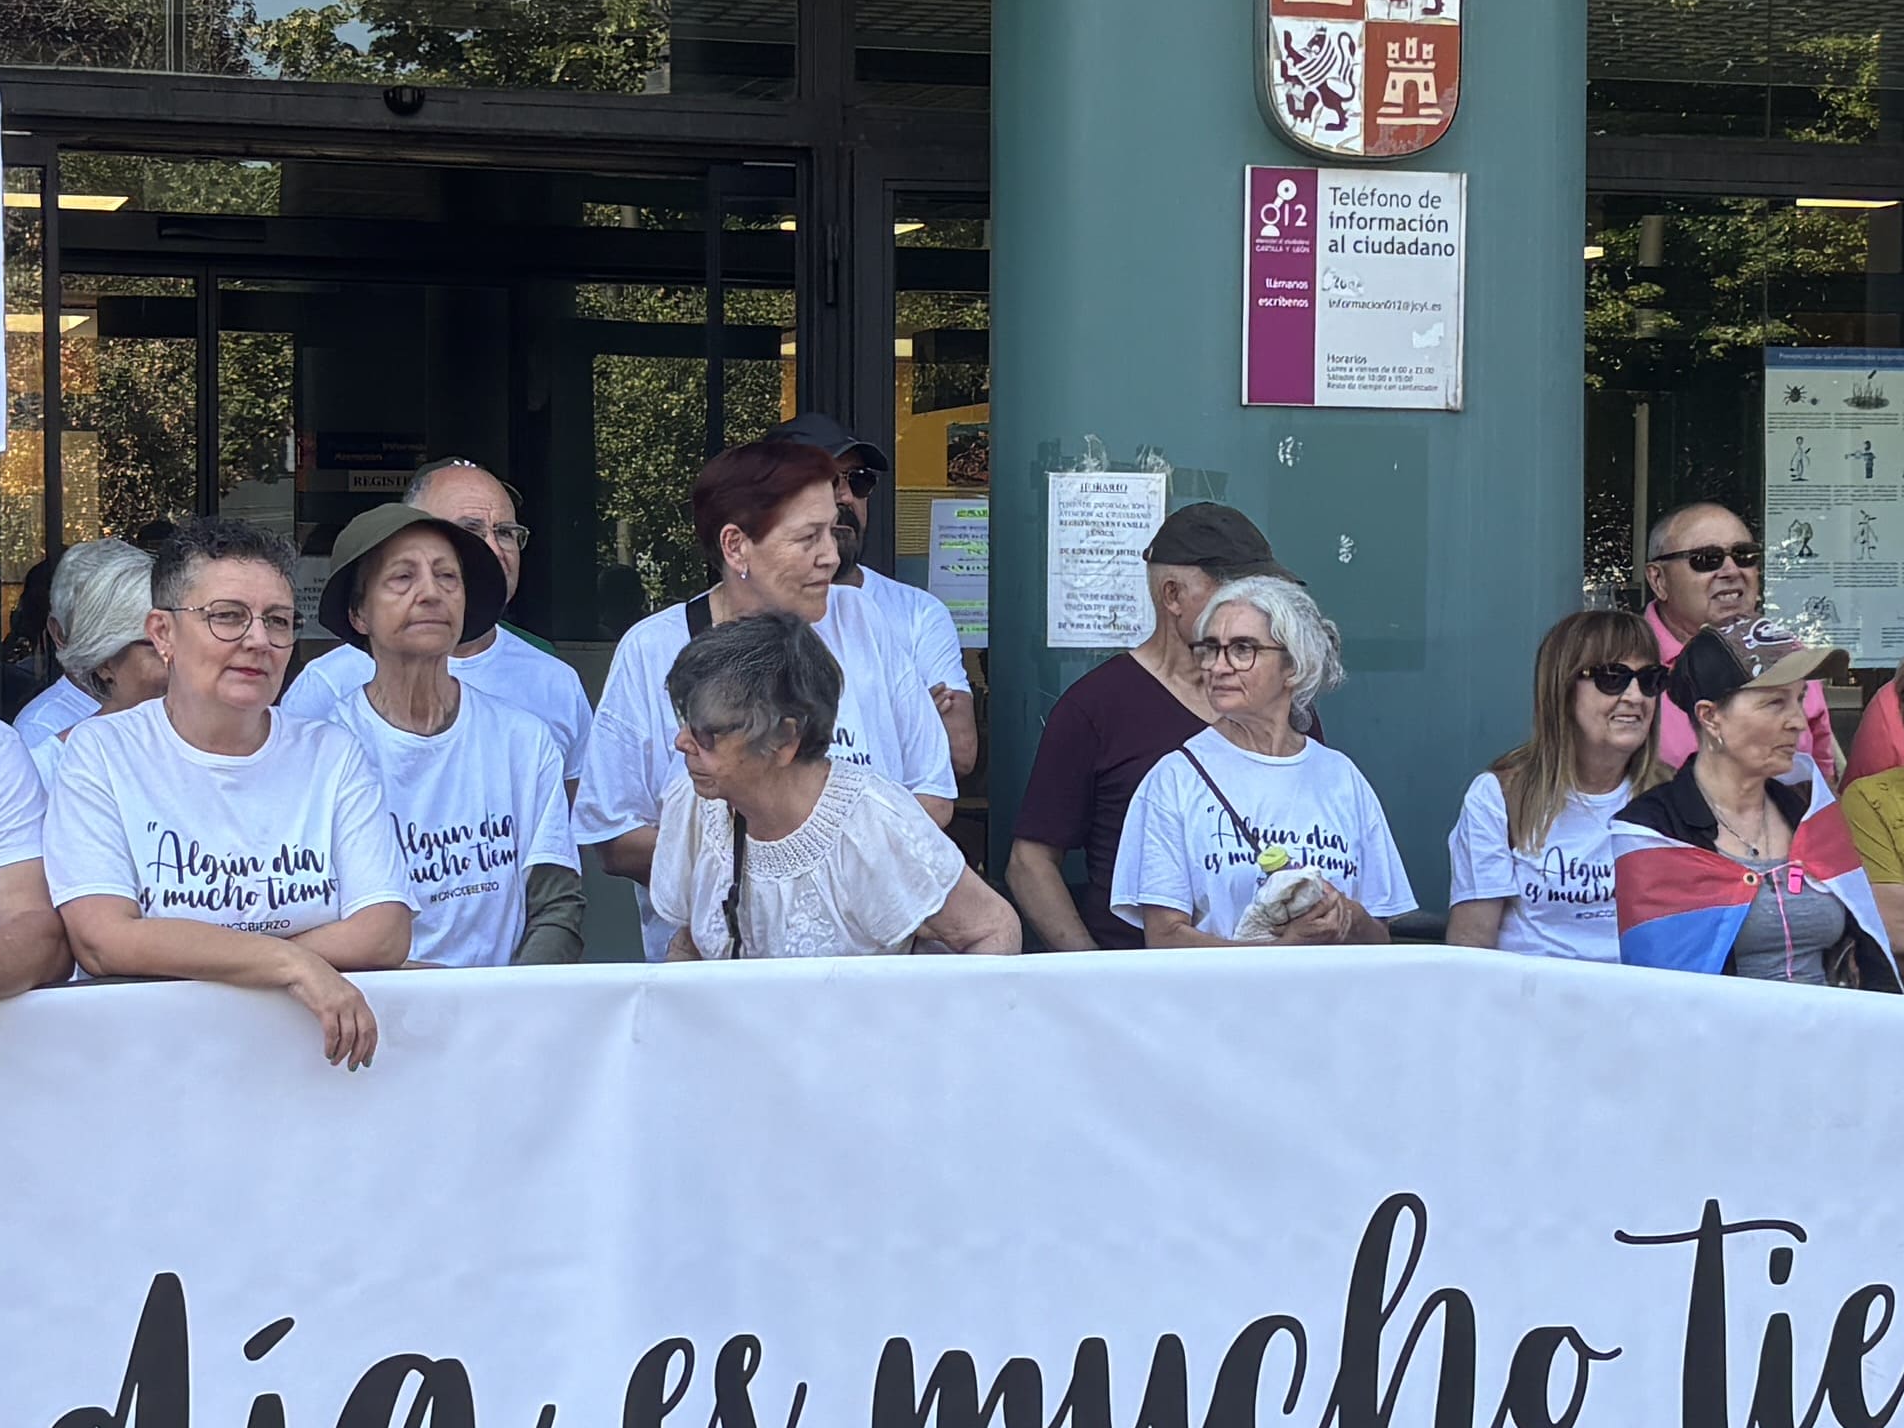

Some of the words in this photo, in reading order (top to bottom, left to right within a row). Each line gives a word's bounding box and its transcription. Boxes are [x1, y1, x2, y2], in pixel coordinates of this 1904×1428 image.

[1328, 184, 1412, 209] Teléfono
[1418, 189, 1442, 210] de
[1328, 210, 1449, 234] información
[1328, 235, 1347, 255] al
[1352, 237, 1456, 257] ciudadano
[146, 820, 265, 886] "Algún
[272, 842, 325, 874] día
[162, 880, 262, 912] mucho
